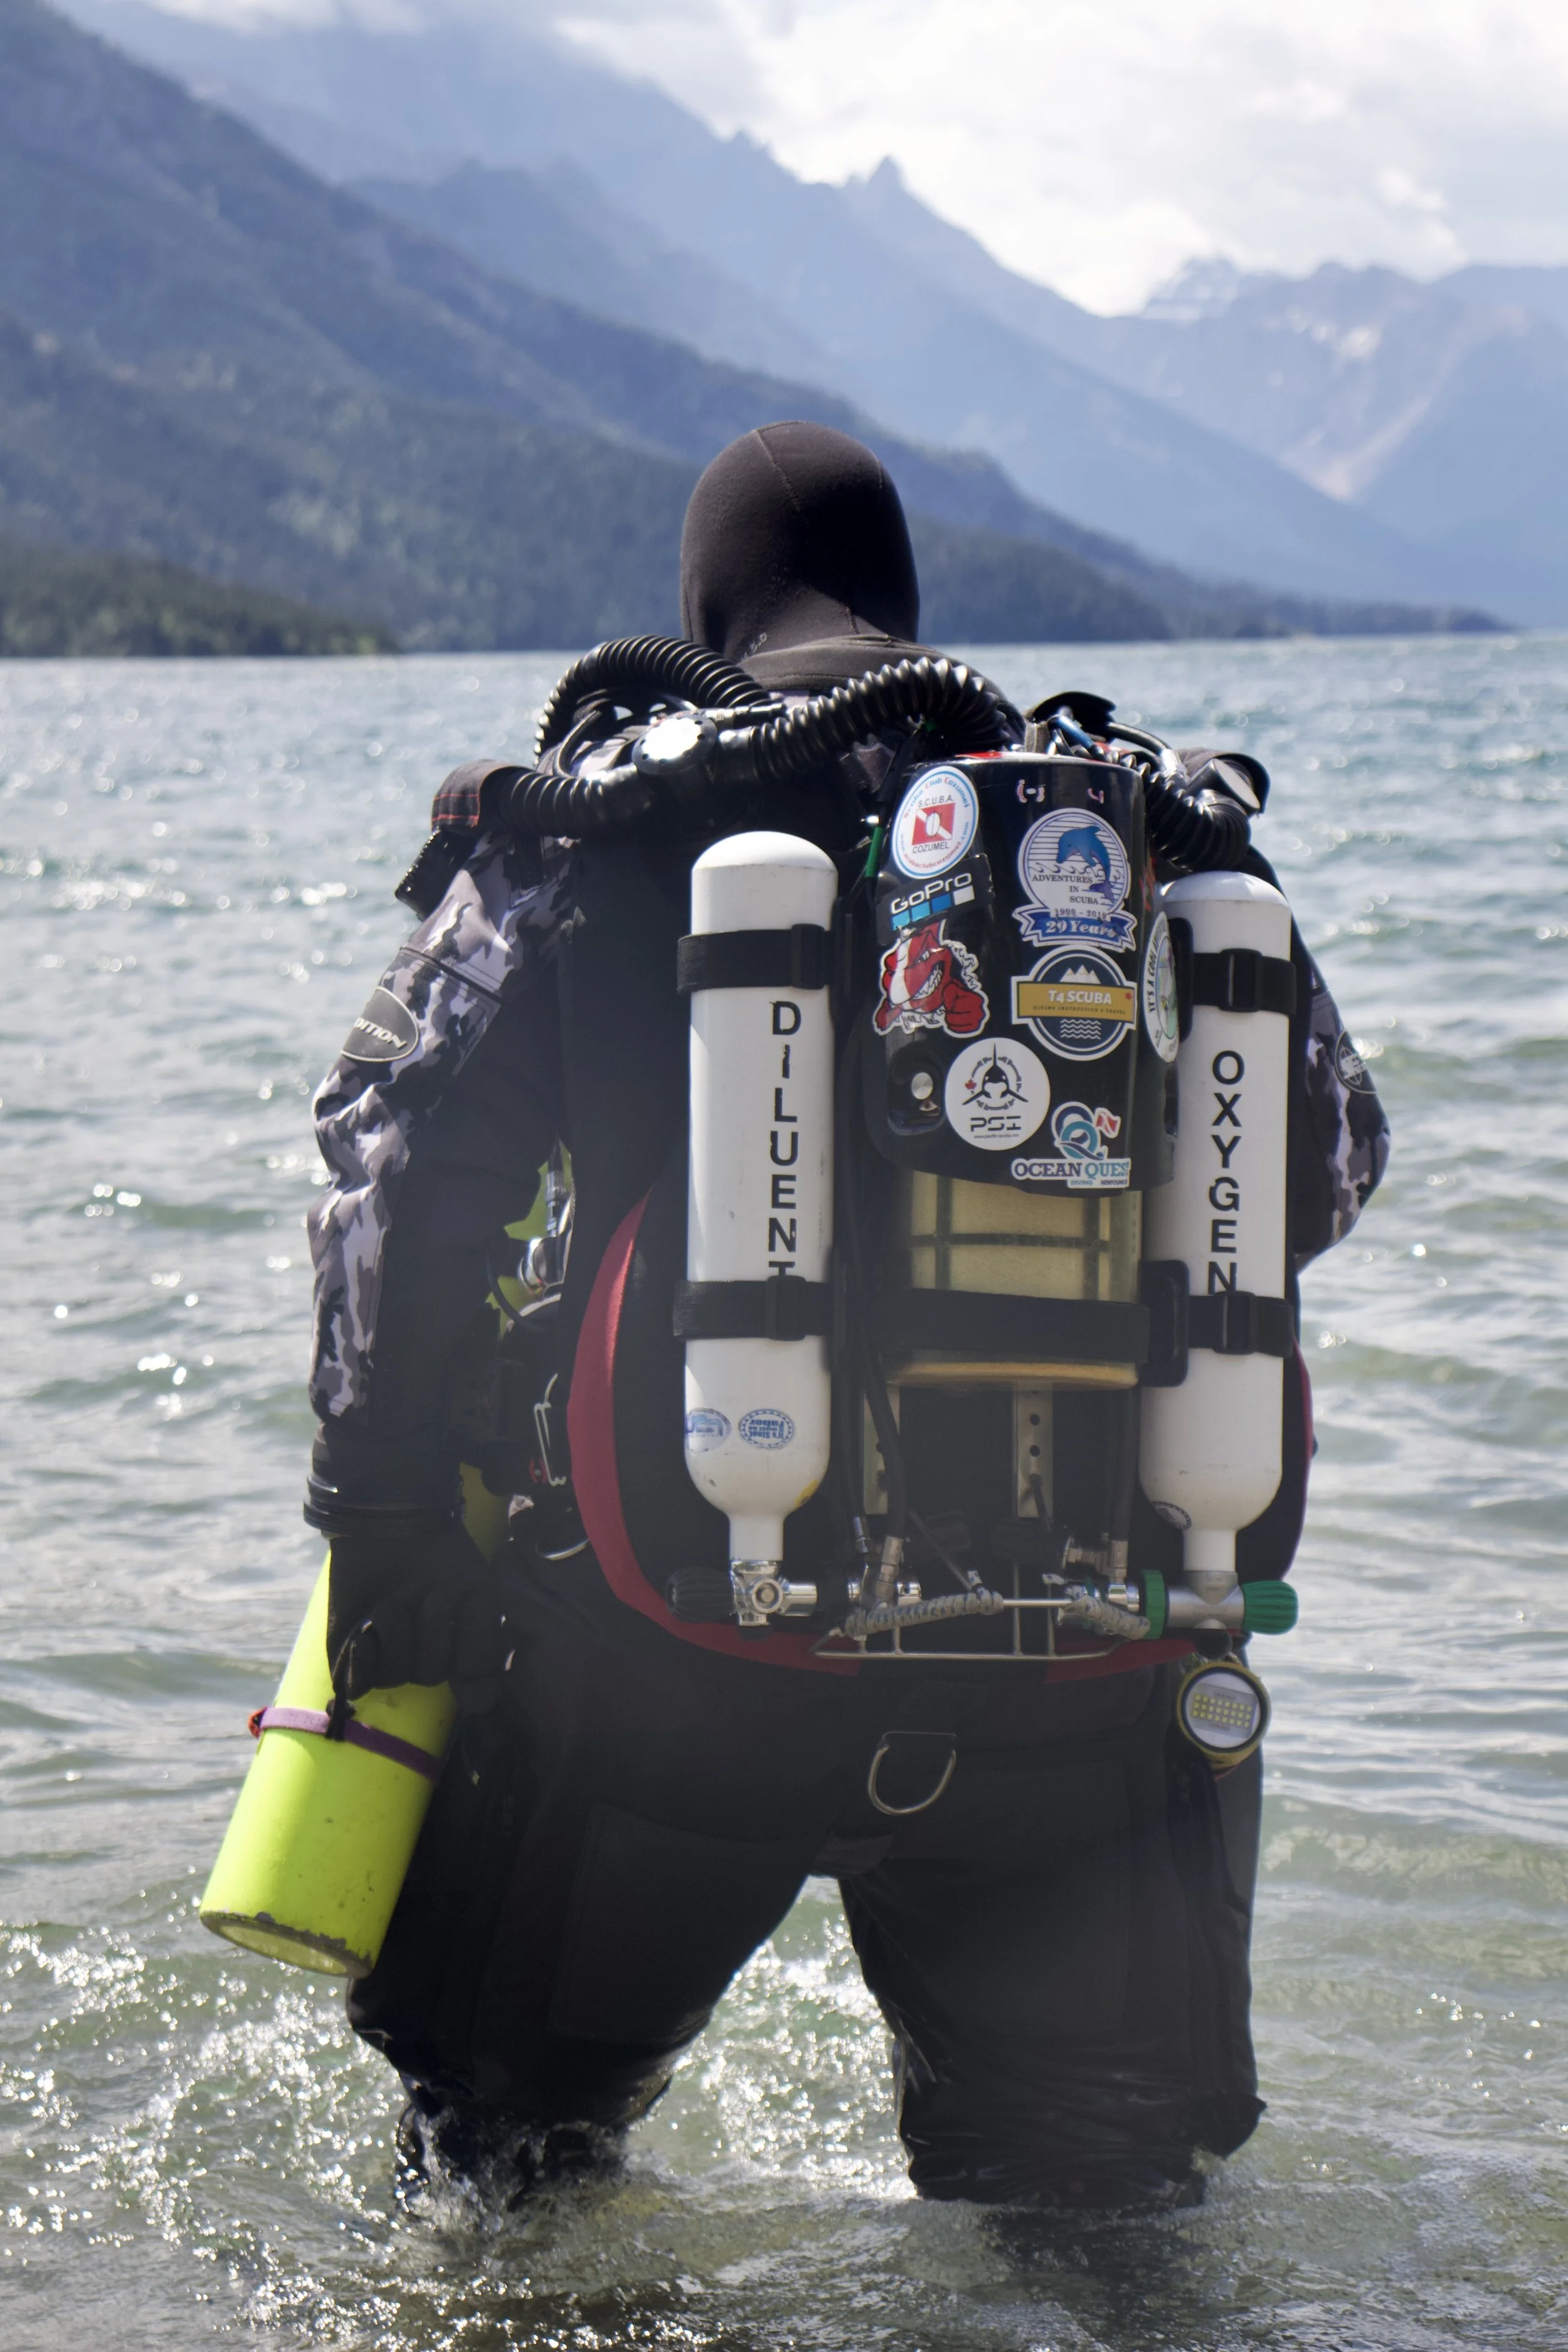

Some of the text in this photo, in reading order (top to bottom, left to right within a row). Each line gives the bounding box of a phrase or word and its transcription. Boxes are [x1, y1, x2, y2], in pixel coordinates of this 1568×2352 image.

[926, 778, 942, 788] Club
[944, 776, 970, 807] Cozumel
[918, 793, 954, 807] S.C.U.B.A.
[912, 841, 950, 854] COZUMEL
[1032, 874, 1093, 884] ADVENTURES
[891, 872, 972, 914] GoPro
[1069, 896, 1099, 905] SCUBA
[1069, 920, 1118, 938] Years
[1147, 978, 1155, 987] A
[1048, 989, 1112, 1005] T4 SCUBA
[1014, 1162, 1129, 1180] OCEAN QUES
[1209, 1050, 1245, 1295] OXYGEN
